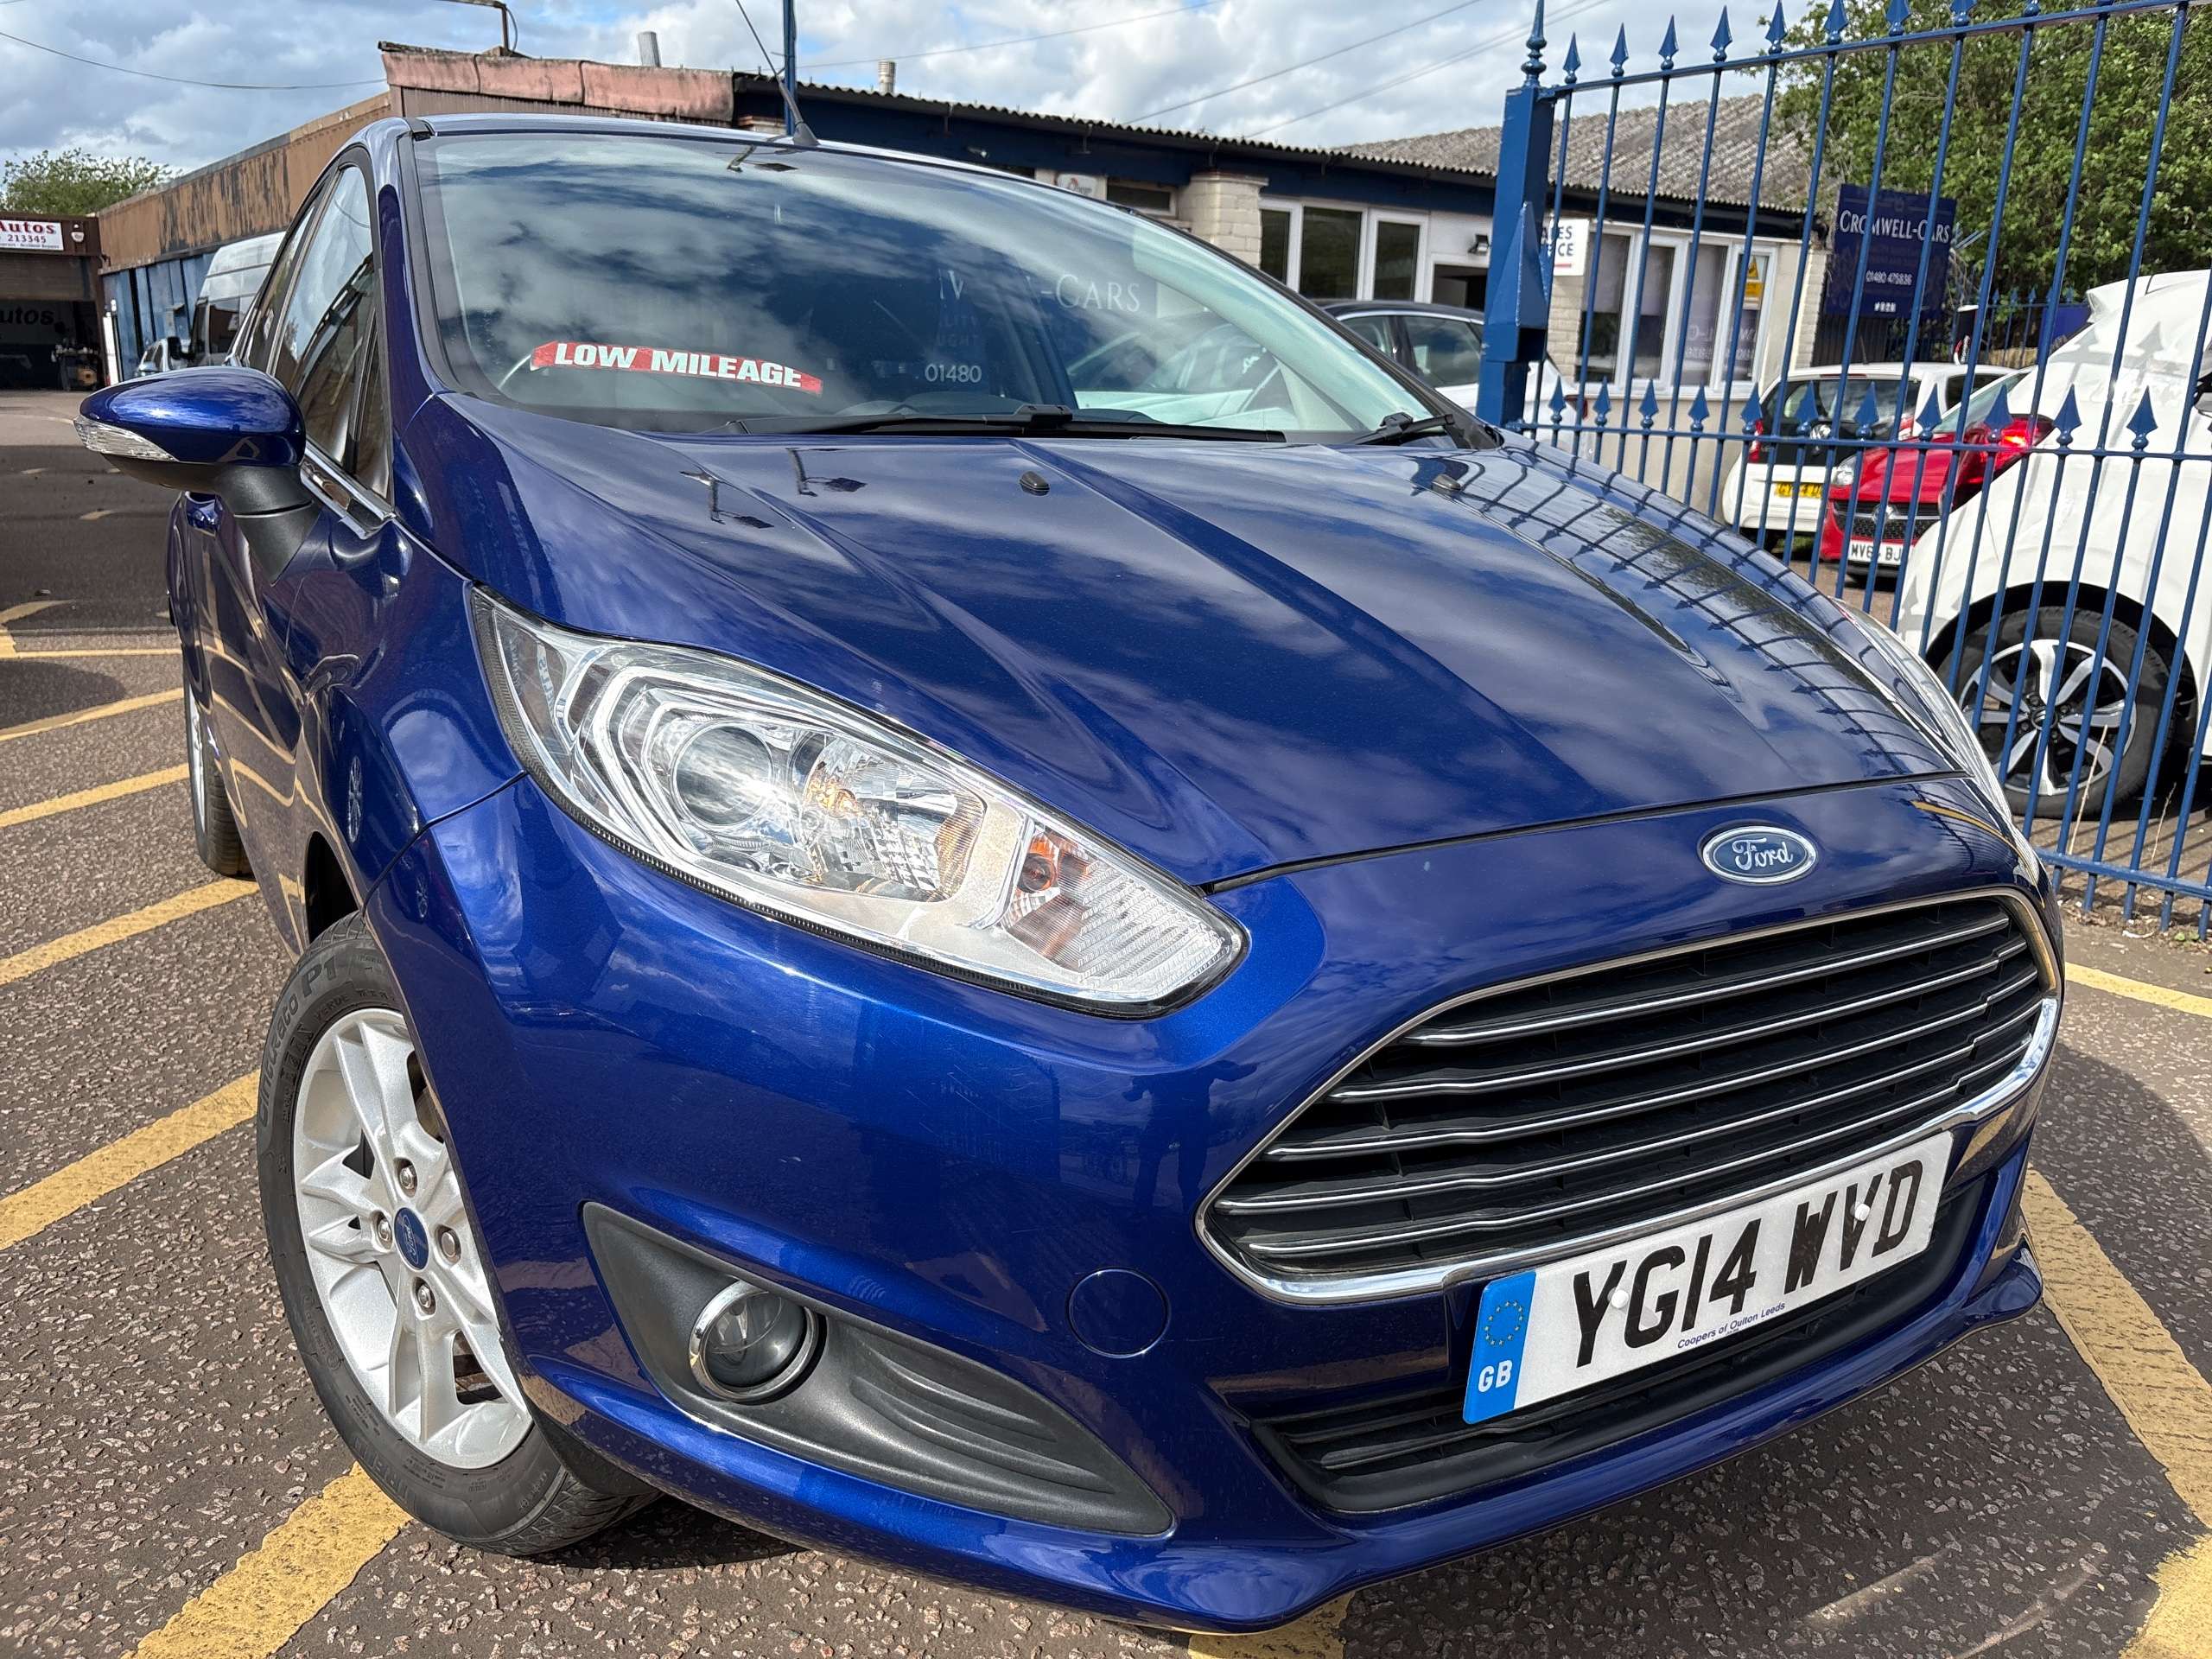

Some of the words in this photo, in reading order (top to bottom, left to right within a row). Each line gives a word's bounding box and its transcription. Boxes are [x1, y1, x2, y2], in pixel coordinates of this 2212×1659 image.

[1840, 210, 1950, 244] CROMWELL-CRS
[554, 343, 638, 369] LOW
[650, 349, 802, 388] MILEAGE
[925, 363, 982, 383] 01480
[1732, 837, 1794, 871] Ford
[301, 956, 337, 998] P1
[1573, 1218, 1761, 1369] YG14
[1783, 1159, 1923, 1295] WVD
[1677, 1329, 1716, 1349] Coopers
[1718, 1323, 1728, 1334] of
[1760, 1302, 1785, 1318] Leeds
[1478, 1359, 1513, 1393] GB
